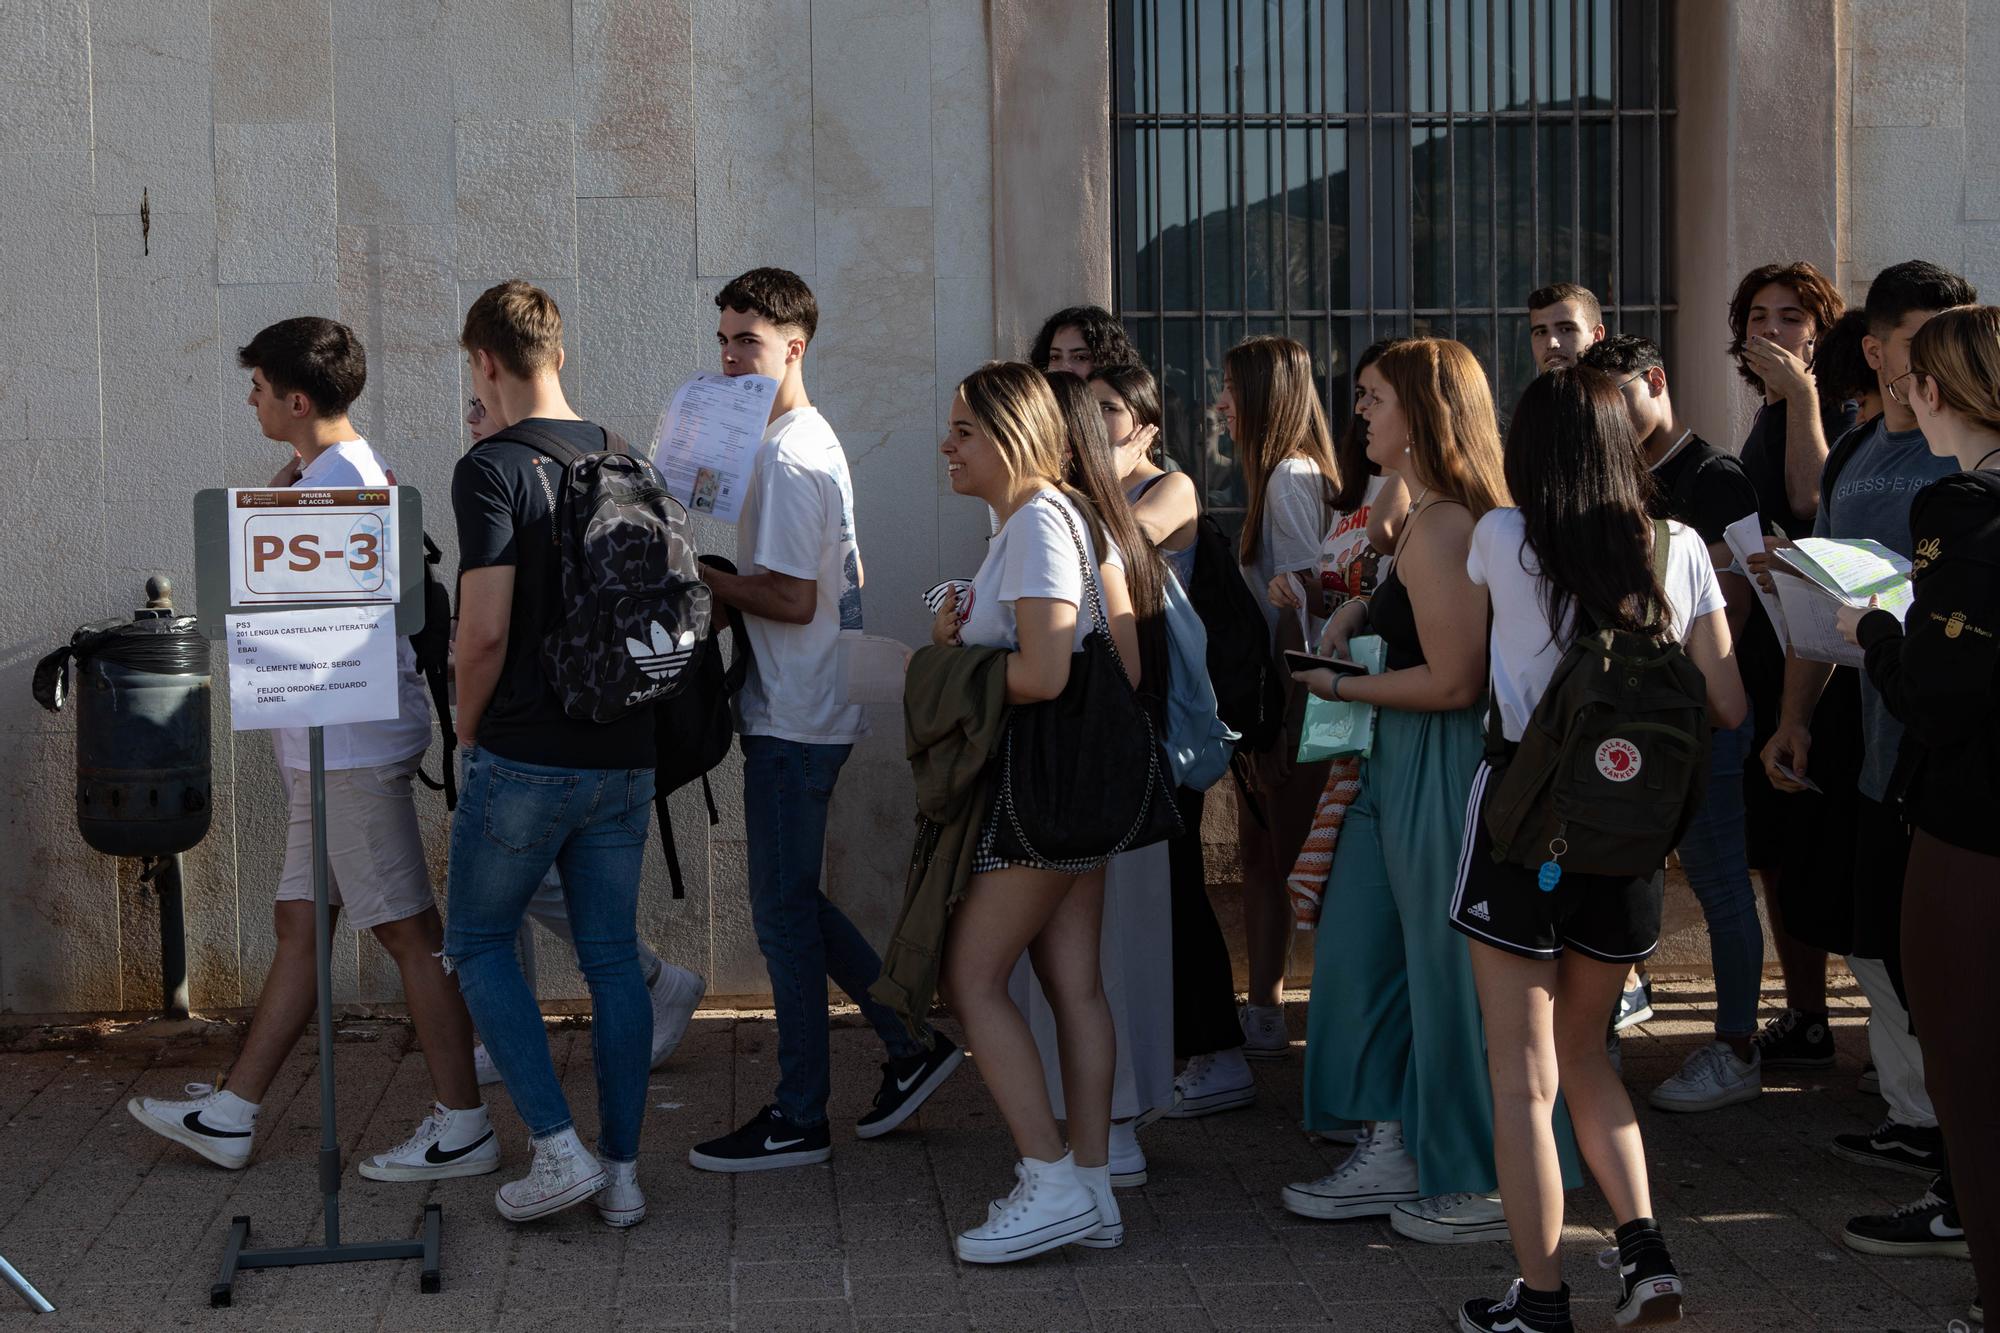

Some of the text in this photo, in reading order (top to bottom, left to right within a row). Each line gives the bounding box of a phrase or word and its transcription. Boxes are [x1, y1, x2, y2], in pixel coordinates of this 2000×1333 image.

[253, 533, 379, 573] PS-3
[250, 629, 279, 637] LENGUA
[280, 626, 327, 635] CASTELLANA
[335, 623, 379, 632] LITERATURA
[256, 659, 361, 673] CLEMENTE MUÑOZ, SERGIO
[257, 680, 368, 695] FEIJOO ORDOÑEZ, EDUARDO
[257, 695, 286, 704] DANIEL
